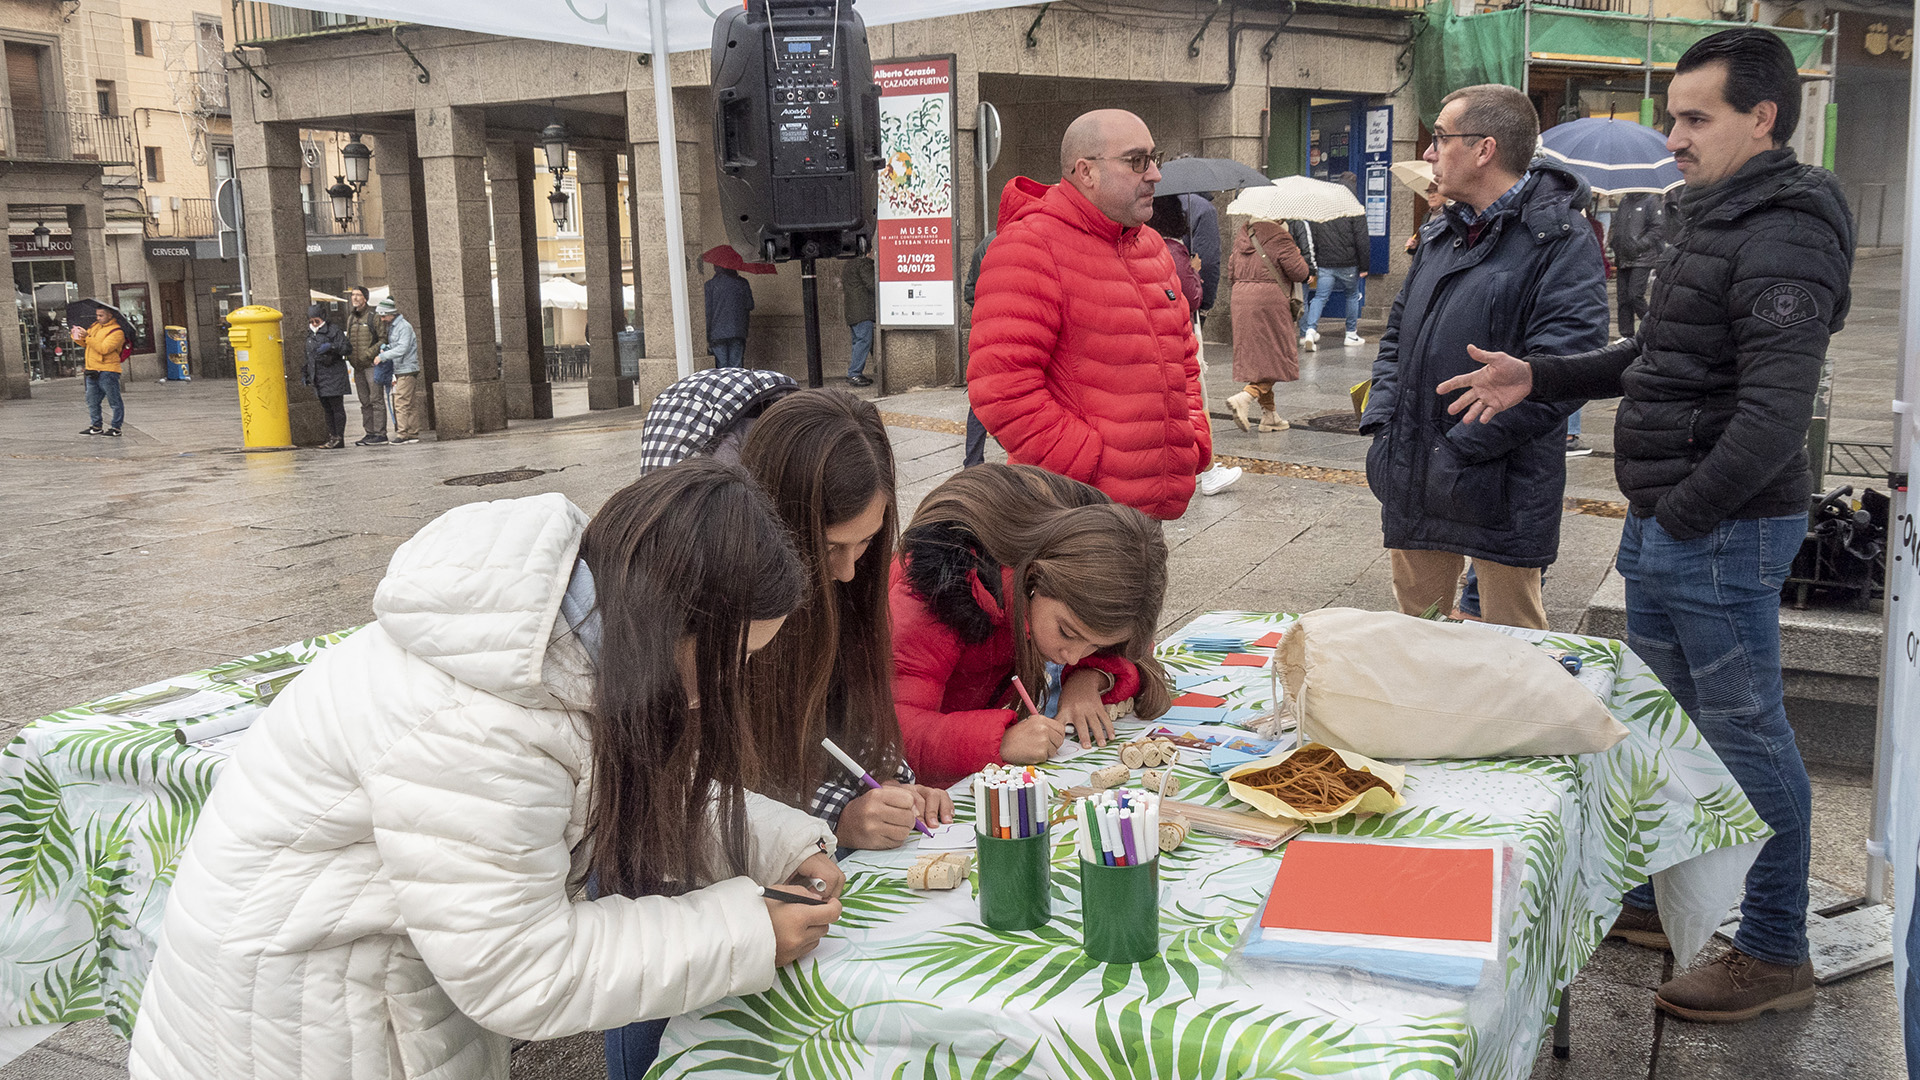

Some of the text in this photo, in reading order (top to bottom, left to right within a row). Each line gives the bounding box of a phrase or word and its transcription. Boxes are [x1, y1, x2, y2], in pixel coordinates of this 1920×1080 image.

[874, 66, 936, 79] Alberto Corazón
[883, 78, 919, 88] CAZADOR
[919, 75, 949, 86] FURTIVO
[900, 226, 939, 235] MUSEO
[26, 242, 38, 251] EL
[152, 245, 190, 256] CERVECERÍA
[351, 243, 375, 251] ARTESANA
[897, 254, 936, 264] 21/10/22
[897, 263, 936, 274] 08/01/23
[1763, 285, 1810, 302] ZAVETTI
[1762, 309, 1807, 324] CANADA
